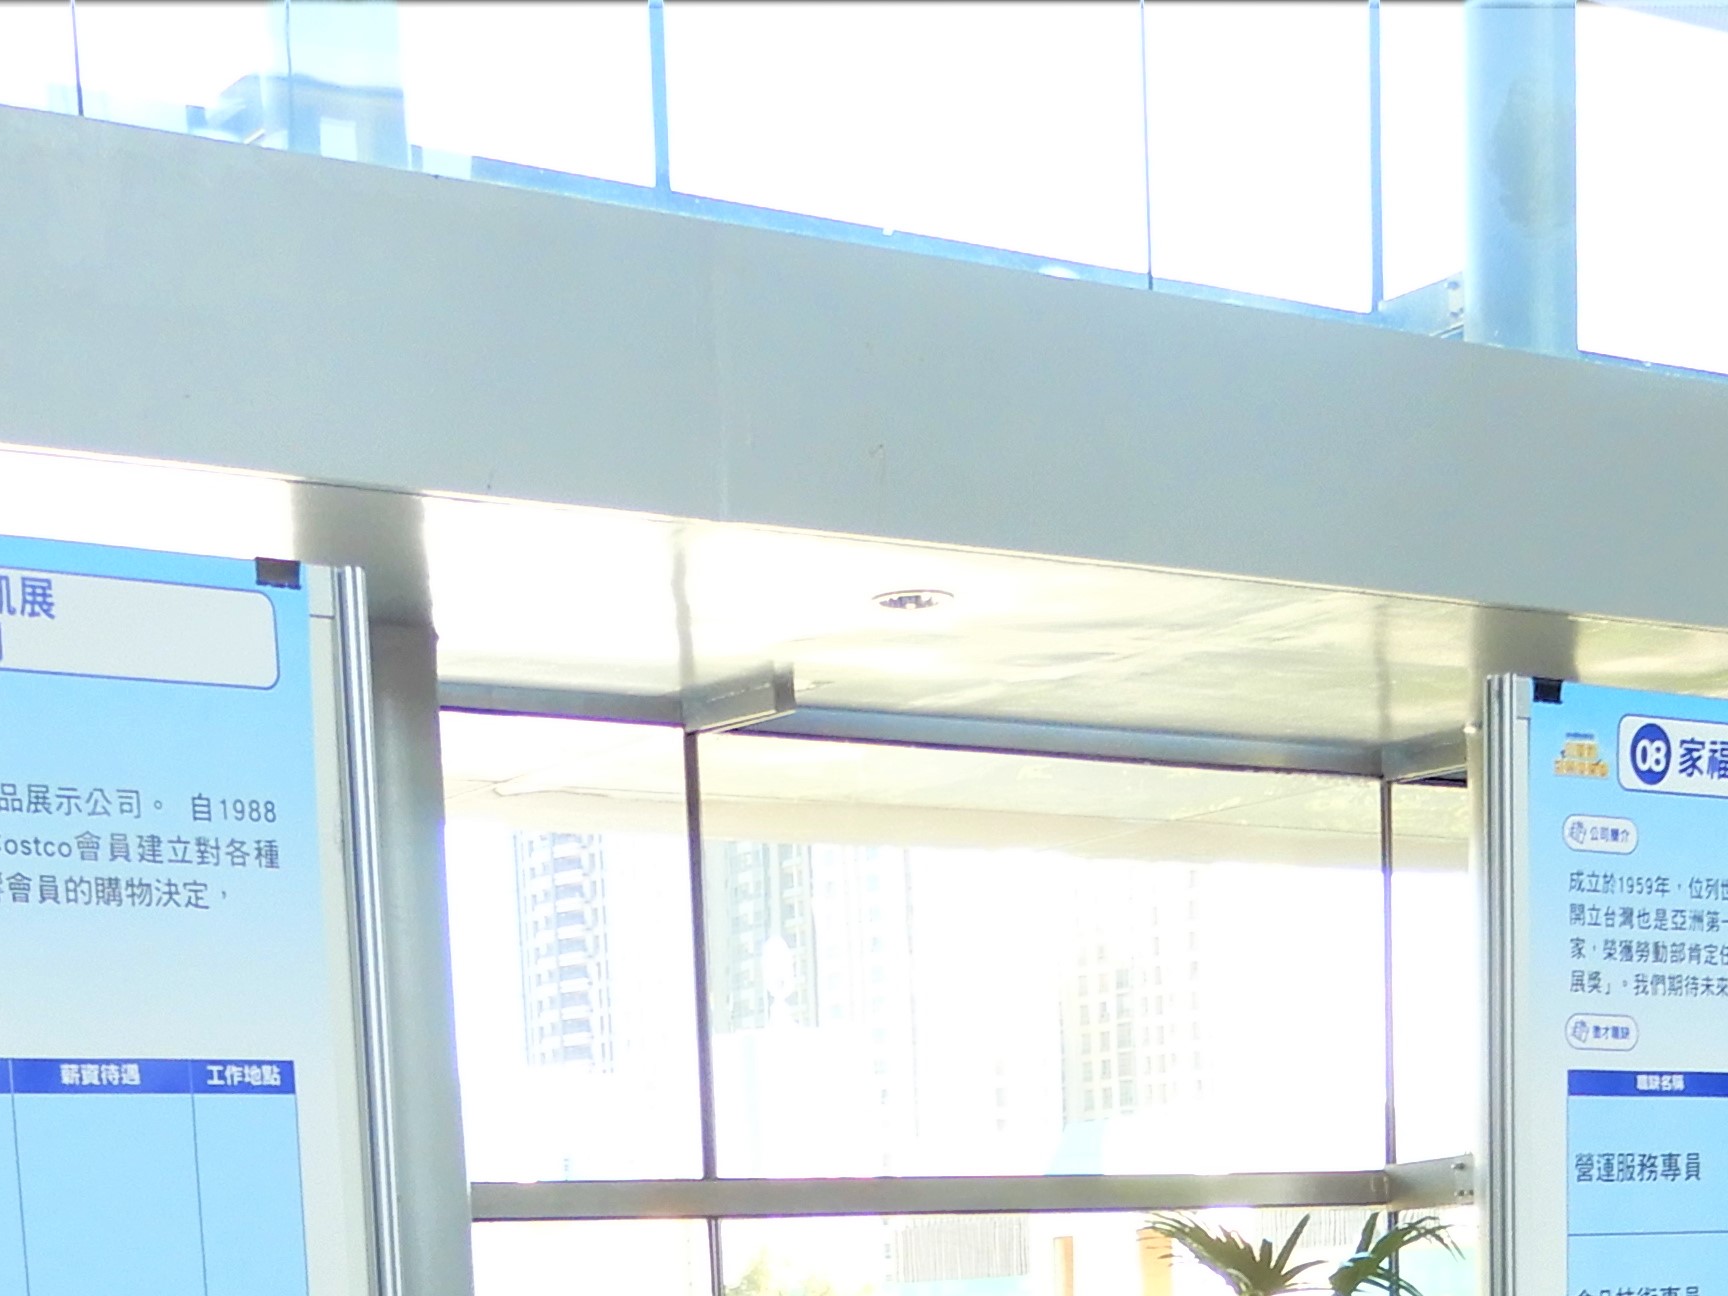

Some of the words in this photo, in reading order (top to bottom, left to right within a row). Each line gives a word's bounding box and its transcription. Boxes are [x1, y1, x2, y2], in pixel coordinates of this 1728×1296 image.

[190, 792, 277, 823] 自1988
[59, 1062, 141, 1087] 薪資待遇
[205, 1063, 282, 1088] 工作地點
[1574, 1152, 1702, 1183] 營運服務專員
